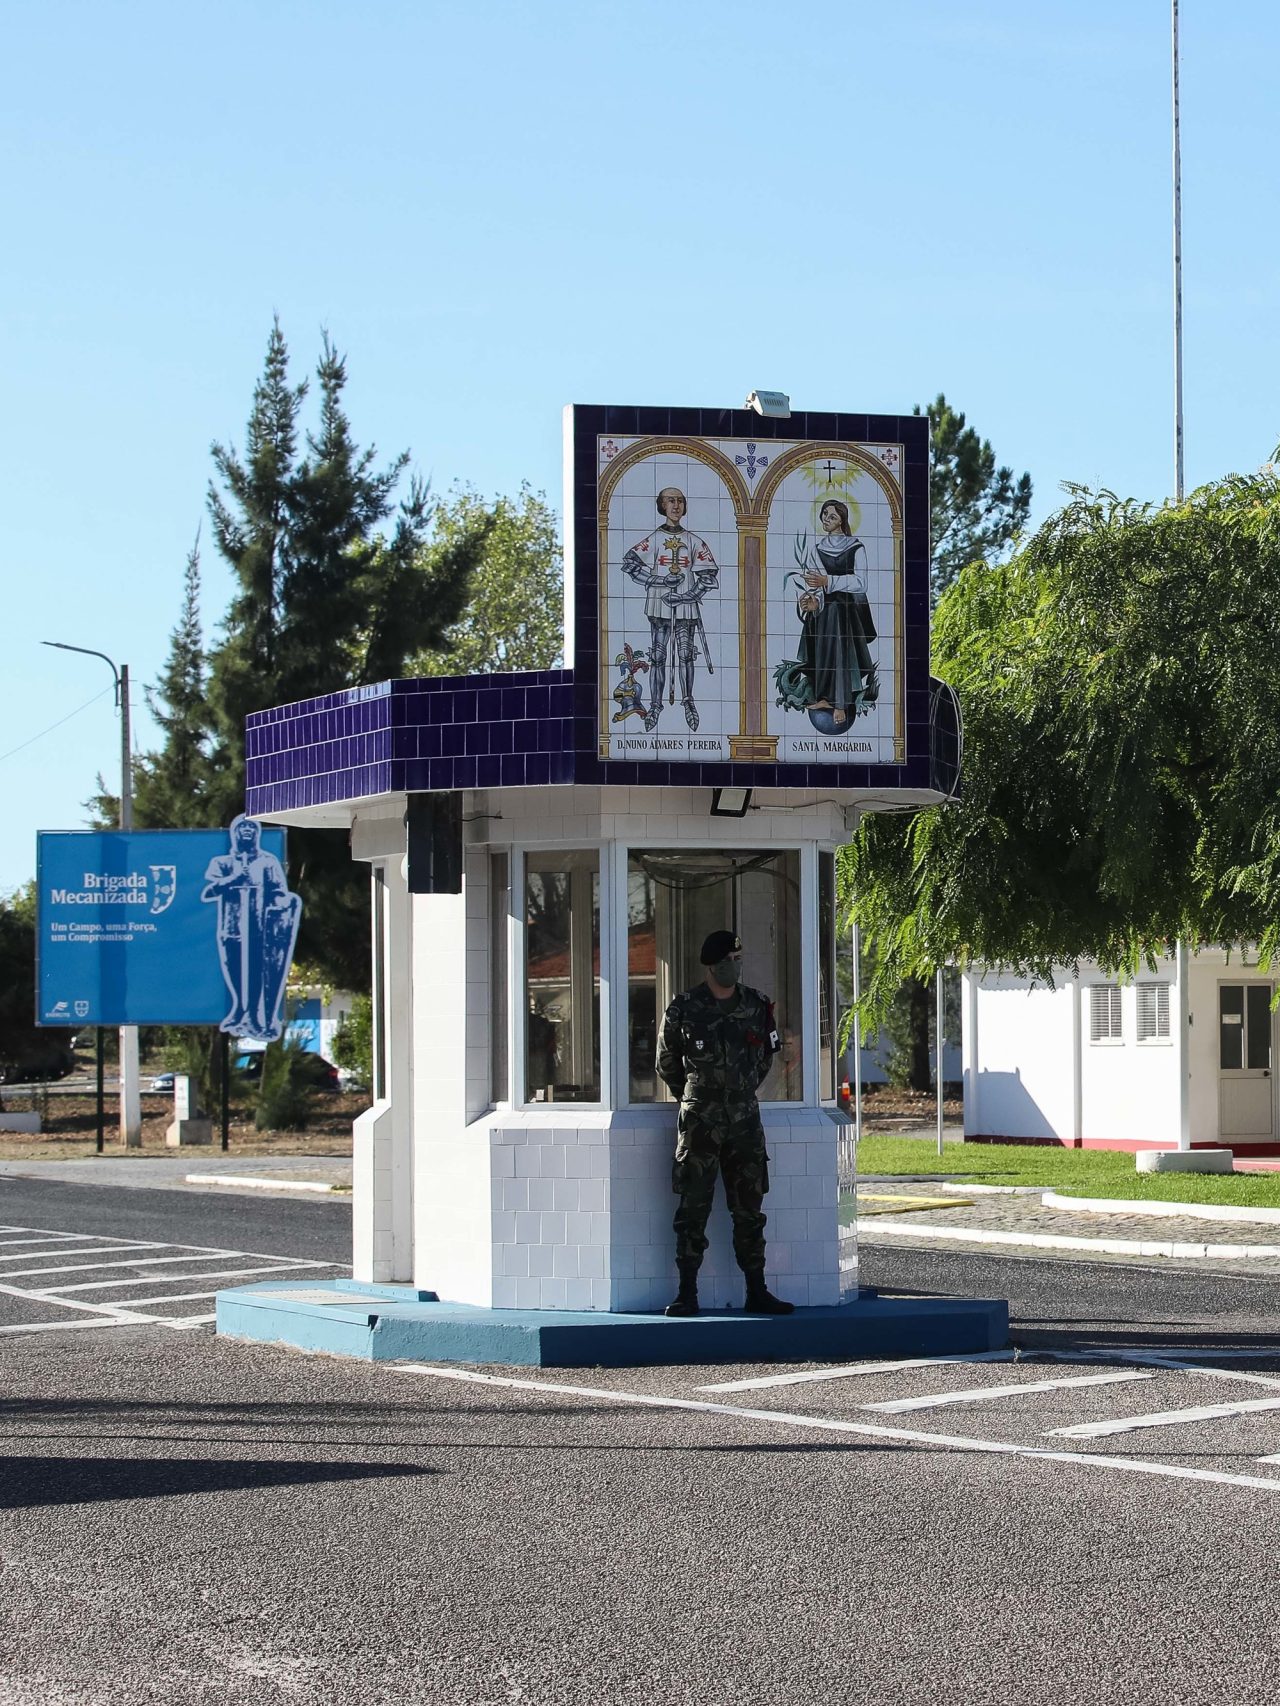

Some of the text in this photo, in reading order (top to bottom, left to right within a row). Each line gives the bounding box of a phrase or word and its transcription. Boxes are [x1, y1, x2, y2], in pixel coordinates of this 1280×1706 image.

[687, 740, 722, 751] PEREIRA
[792, 740, 873, 753] SANTA MARGARIDA
[83, 872, 148, 892] Brigada
[51, 888, 147, 904] Mecanizada
[51, 922, 67, 931] Um
[69, 923, 104, 933] Campo,
[128, 922, 157, 933] Força,
[69, 933, 133, 943] Compromisso
